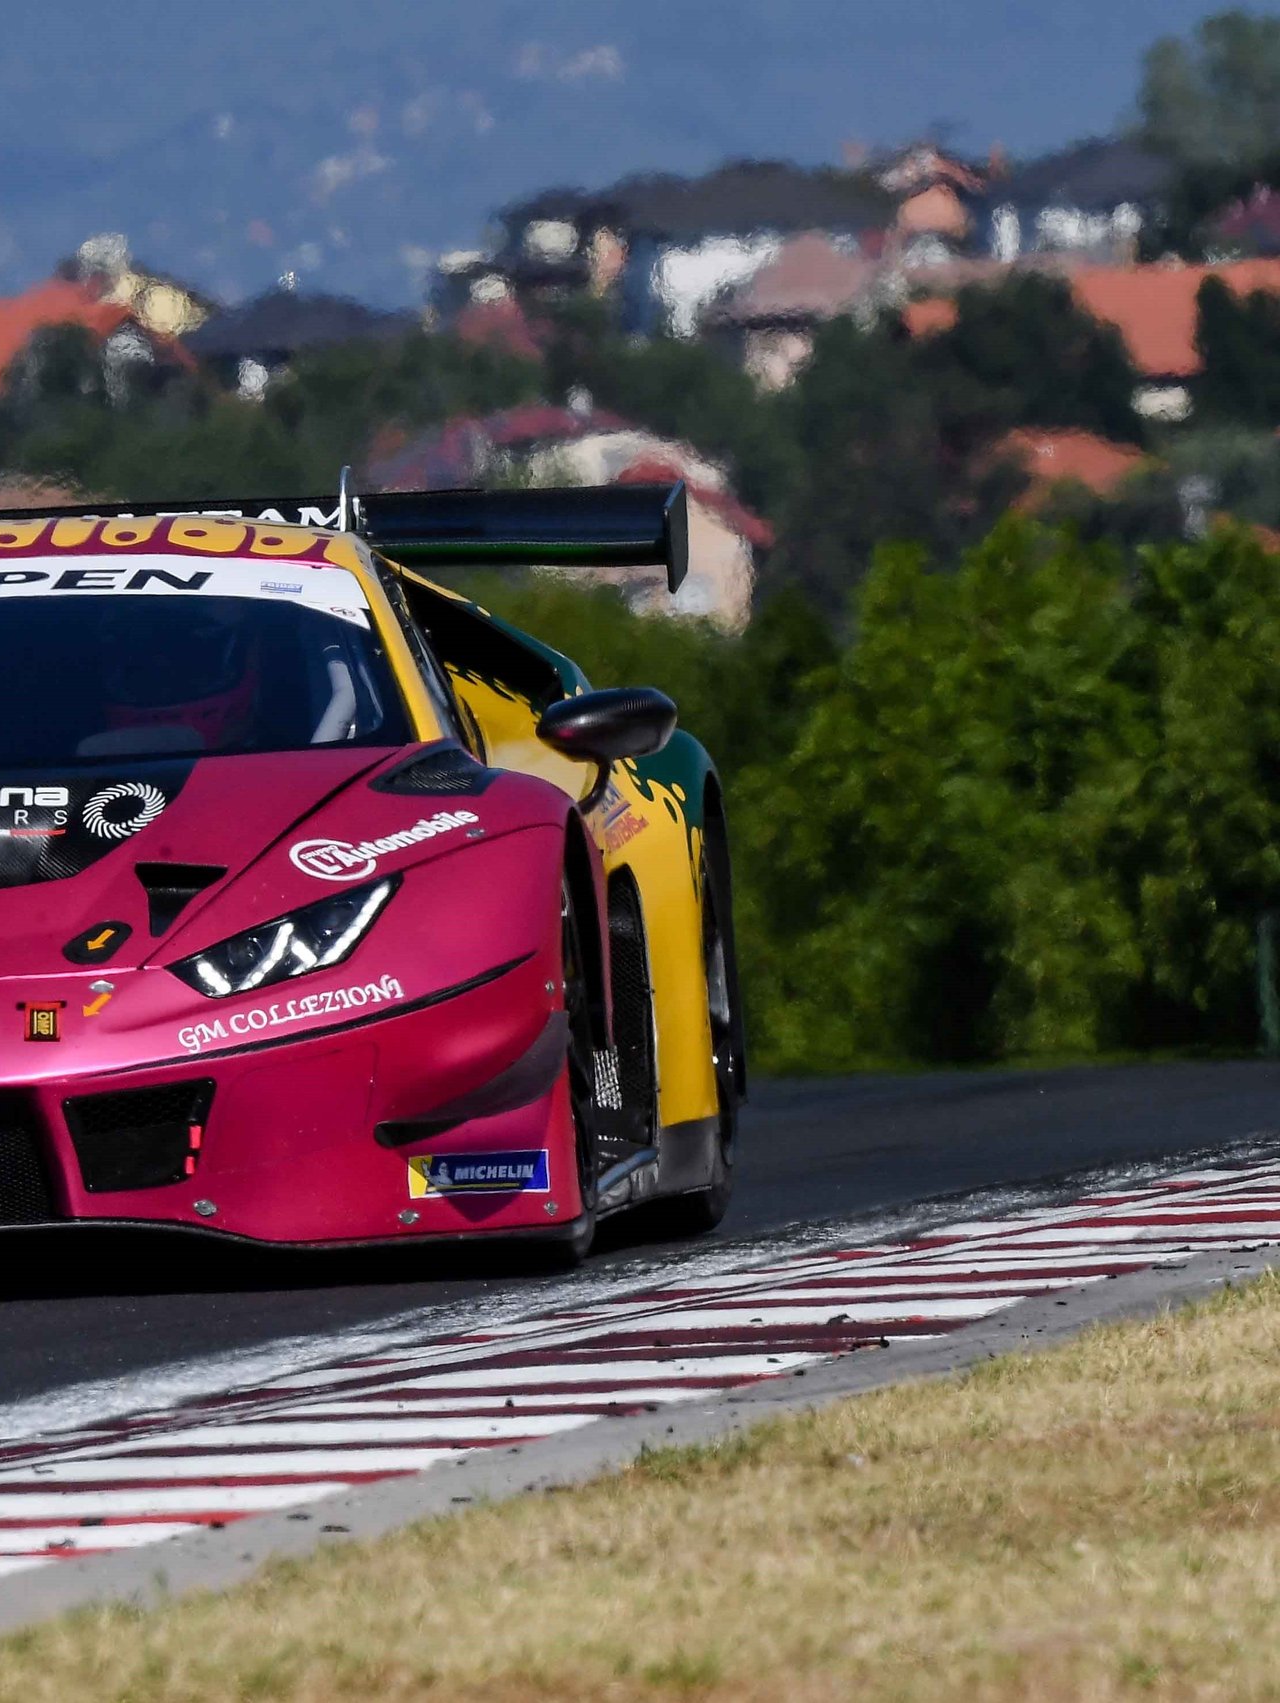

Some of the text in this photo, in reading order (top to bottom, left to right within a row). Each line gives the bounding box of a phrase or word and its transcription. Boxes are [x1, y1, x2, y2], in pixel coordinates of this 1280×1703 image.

[37, 1011, 50, 1035] OMP
[177, 974, 405, 1053] GM COLLEZIONI
[454, 1163, 535, 1180] MICHELIN
